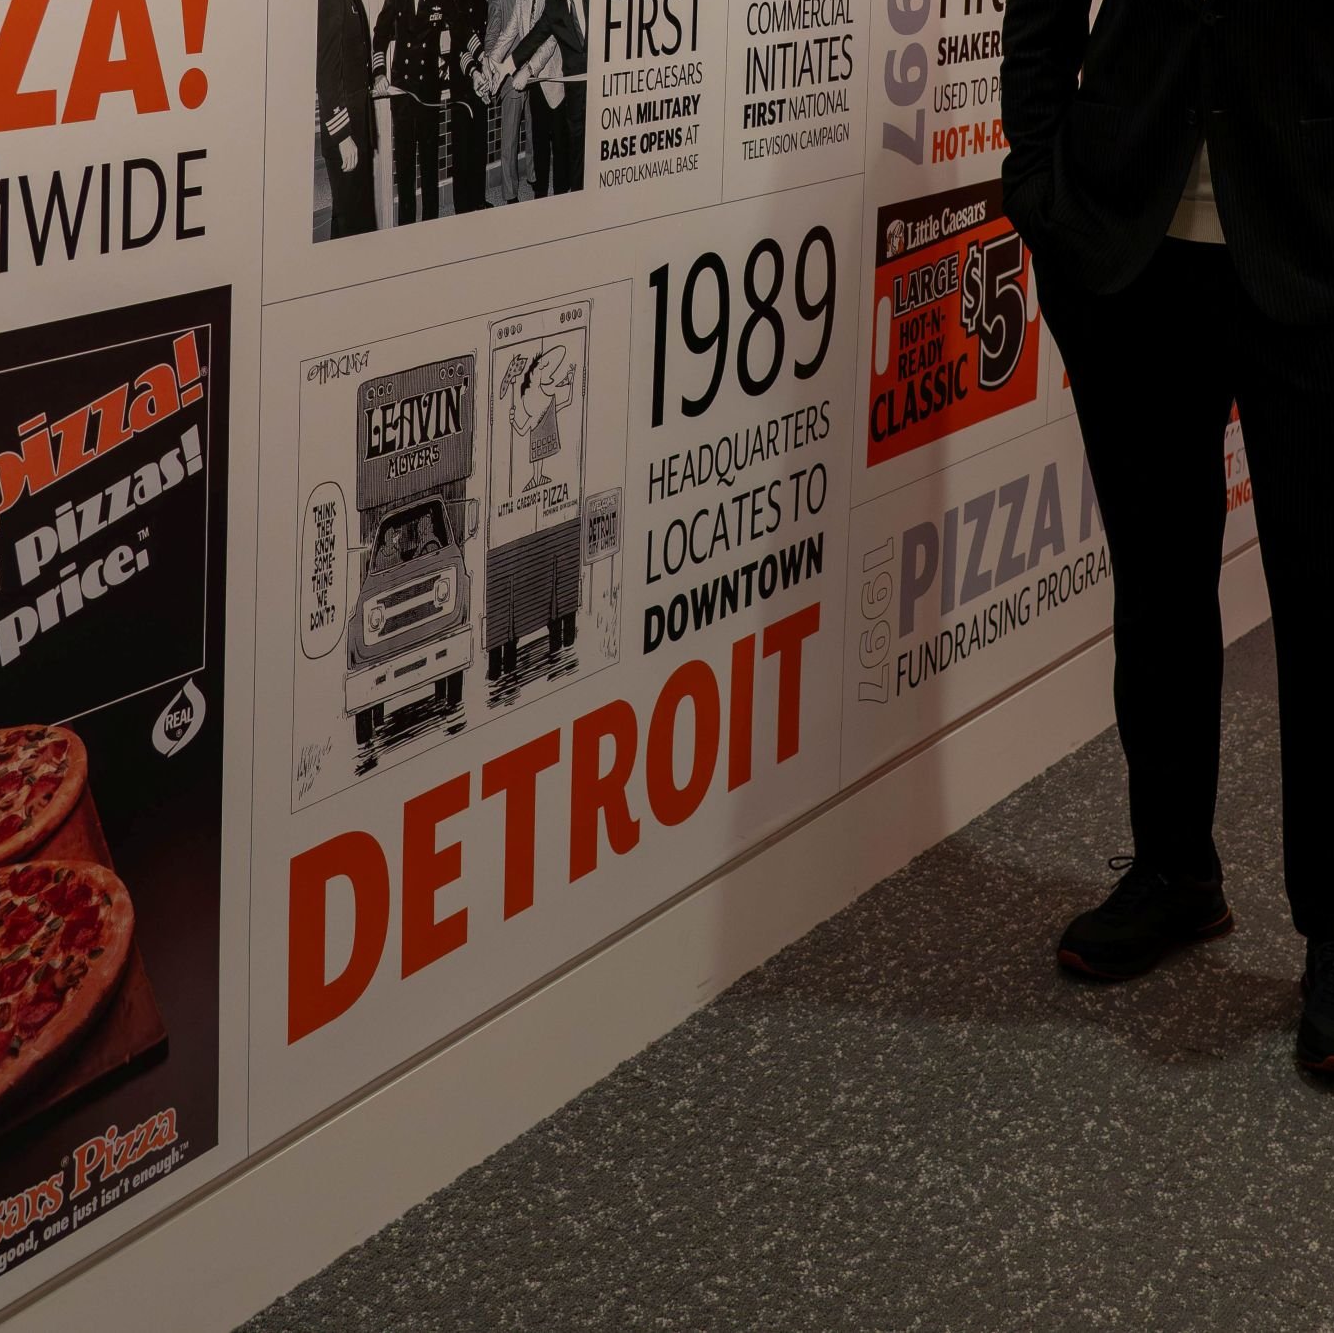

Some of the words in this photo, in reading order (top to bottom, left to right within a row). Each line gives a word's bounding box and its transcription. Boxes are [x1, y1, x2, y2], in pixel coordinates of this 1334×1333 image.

[745, 34, 853, 95] INITIATES
[937, 30, 1003, 66] SHAKER
[636, 94, 701, 125] MILITARY
[743, 99, 786, 129] FIRST
[789, 88, 849, 120] NATIONAL
[600, 135, 637, 161] BASE
[742, 133, 798, 160] TELEVISION
[800, 122, 850, 150] CAMPAIGN
[932, 118, 1010, 164] HOT-N-R
[906, 217, 939, 251] Little
[892, 251, 960, 317] LARGE
[649, 225, 837, 428] 1989
[961, 230, 1027, 392] $5
[898, 334, 945, 382] READY
[870, 353, 969, 443] CLASSIC
[648, 400, 830, 504] HEADQUARTERS
[15, 424, 204, 586] pizzas!
[313, 501, 336, 523] THINK
[589, 511, 617, 543] DETROIT
[646, 480, 781, 586] LOCATES
[790, 462, 827, 523] TO
[315, 535, 335, 557] KNOW
[317, 519, 334, 538] THEY
[899, 461, 1066, 639] PIZZA
[312, 570, 333, 593] THING
[643, 532, 824, 655] DOWNTOWN
[310, 605, 335, 631] DON'T?
[896, 587, 1031, 697] FUNDRAISING
[1036, 546, 1114, 618] PROGRA
[165, 705, 194, 732] REAL
[287, 601, 821, 1047] DETROIT
[69, 1106, 179, 1201] Pizza
[73, 1196, 98, 1229] just
